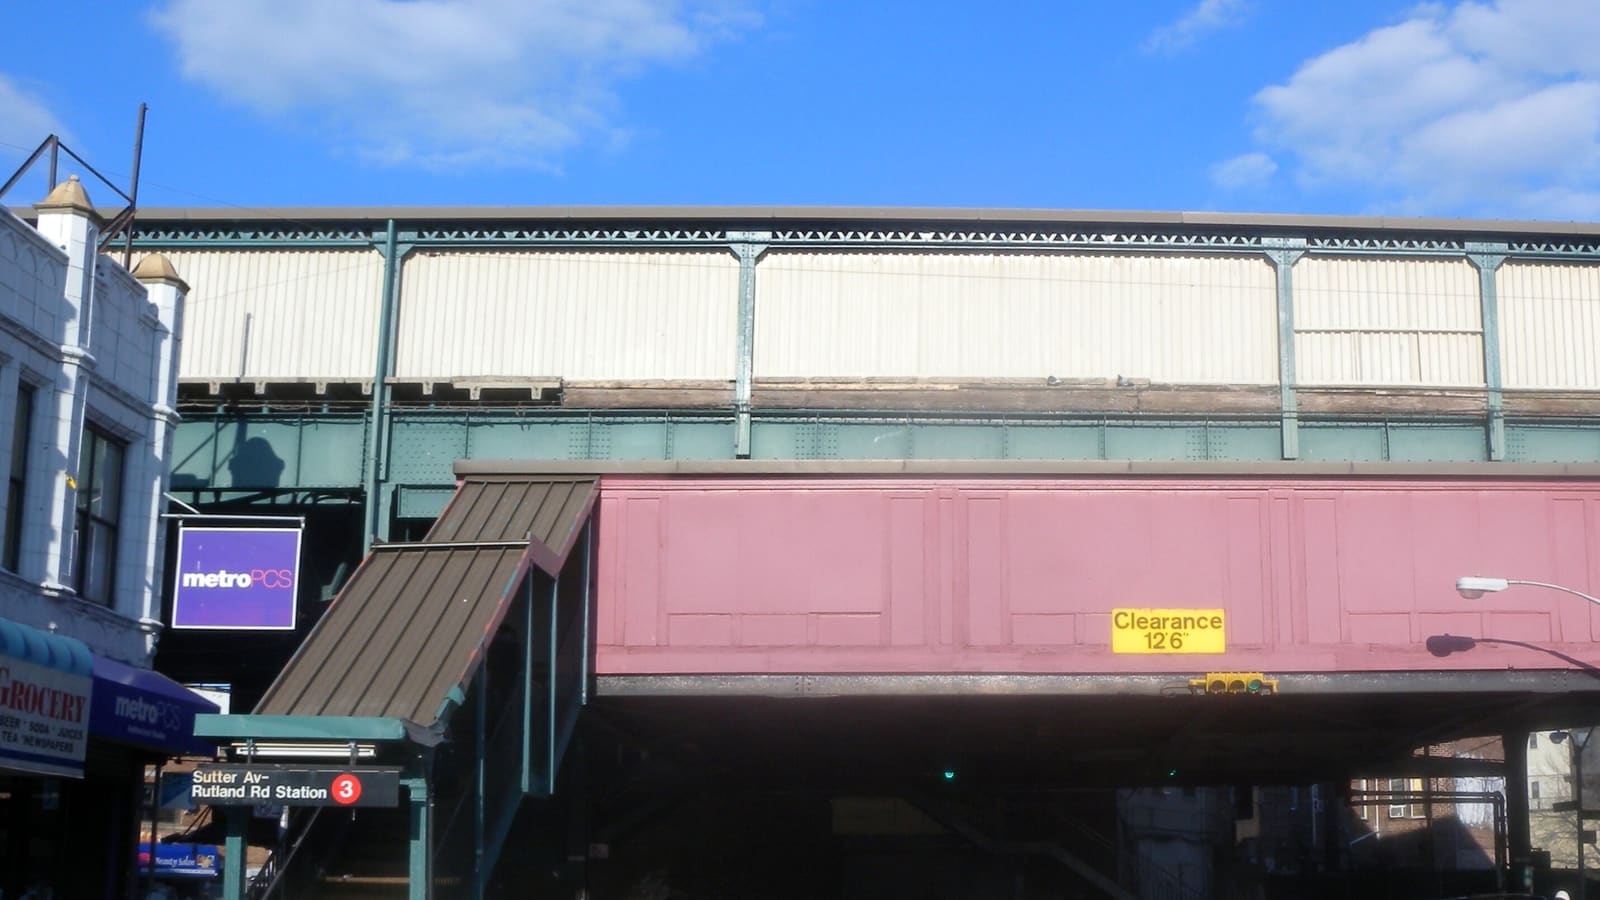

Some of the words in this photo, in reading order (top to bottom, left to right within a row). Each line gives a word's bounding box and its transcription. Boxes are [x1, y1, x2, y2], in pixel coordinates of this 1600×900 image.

[183, 569, 292, 588] metroPCS
[1114, 611, 1223, 630] Clearance
[115, 696, 181, 731] metroPCS
[192, 771, 237, 783] Sutter
[243, 771, 269, 783] Av-
[192, 785, 245, 798] Rutland
[250, 785, 270, 798] Rd
[275, 785, 328, 799] Station
[339, 780, 354, 798] 3
